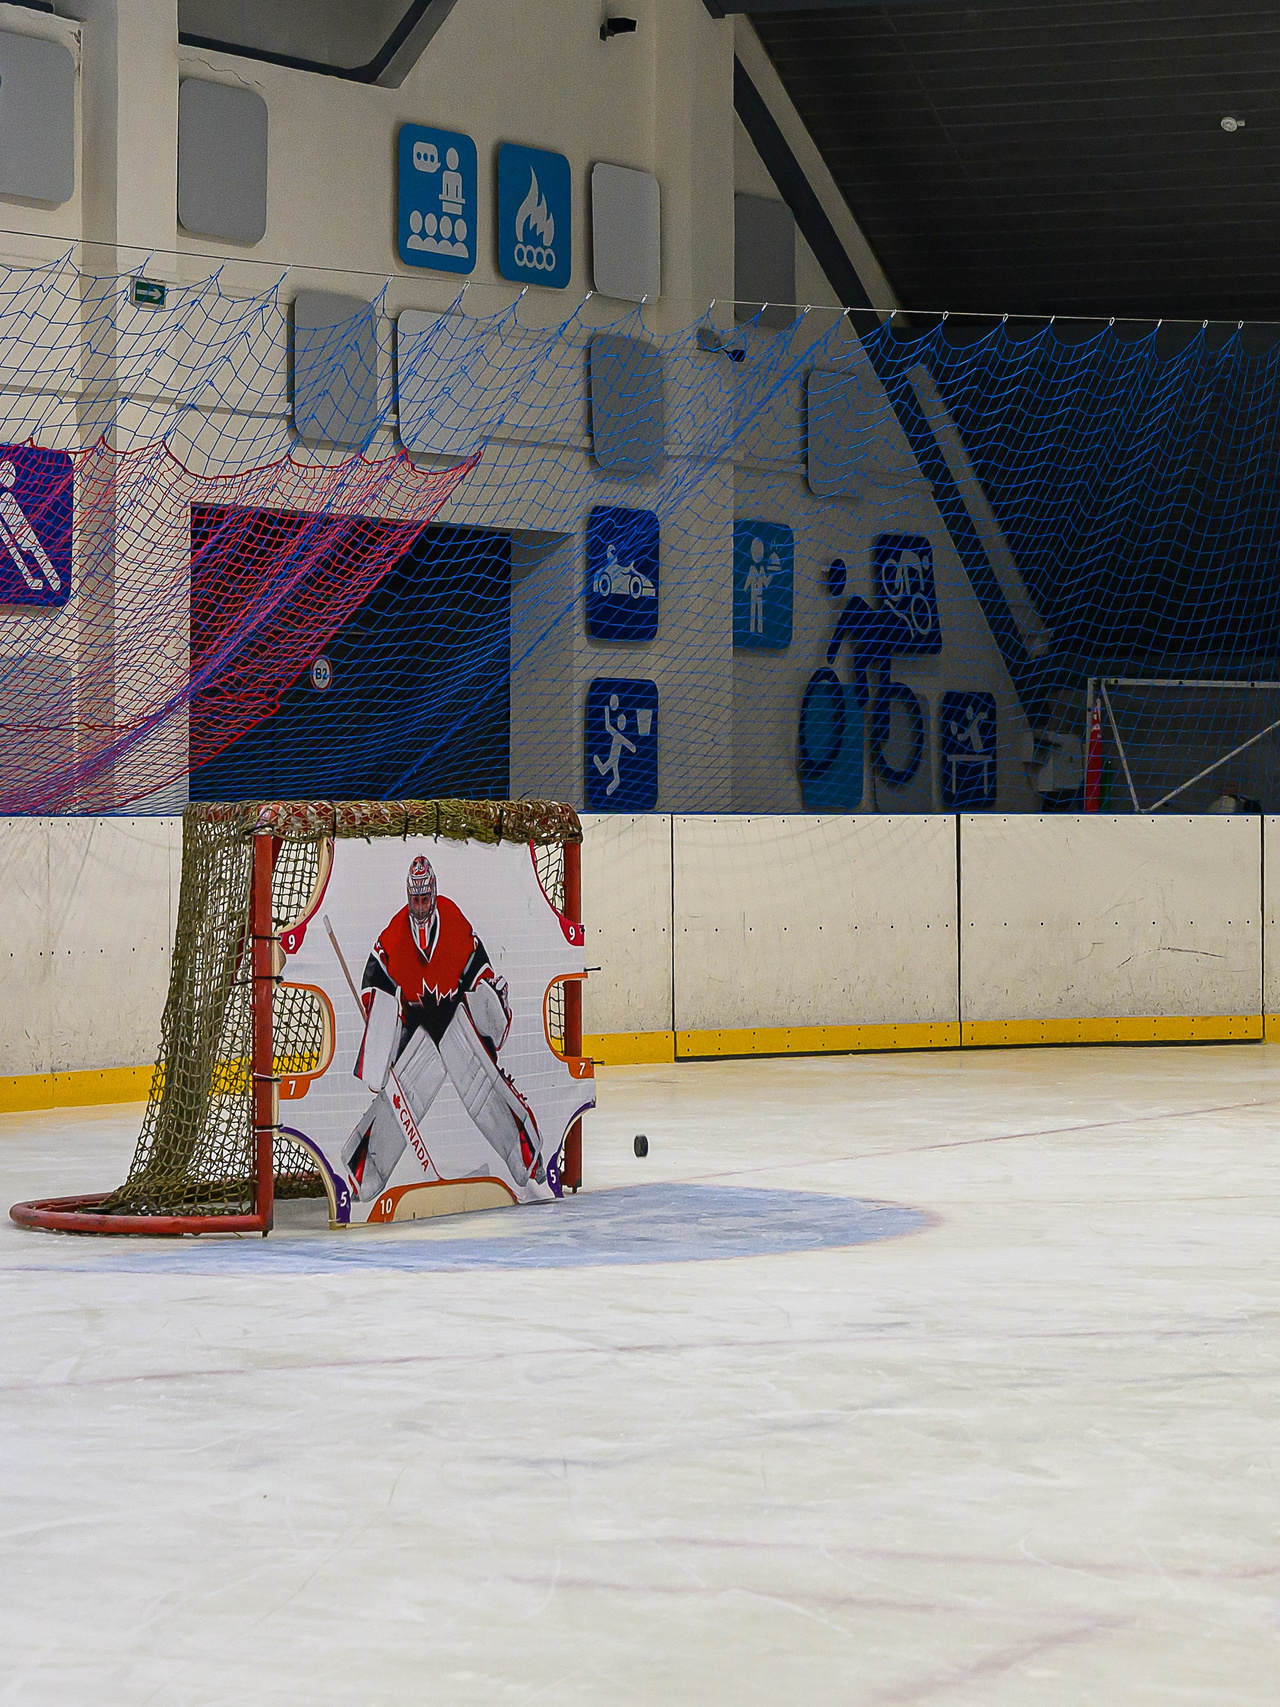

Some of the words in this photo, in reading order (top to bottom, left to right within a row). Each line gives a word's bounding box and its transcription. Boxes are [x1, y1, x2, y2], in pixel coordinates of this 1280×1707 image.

[569, 925, 577, 941] 9
[288, 934, 296, 951] 9
[579, 1062, 586, 1076] 7
[288, 1080, 297, 1096] 7
[399, 1108, 430, 1172] CANADA
[549, 1169, 557, 1184] 5
[340, 1190, 348, 1208] 5
[380, 1197, 394, 1215] 10
